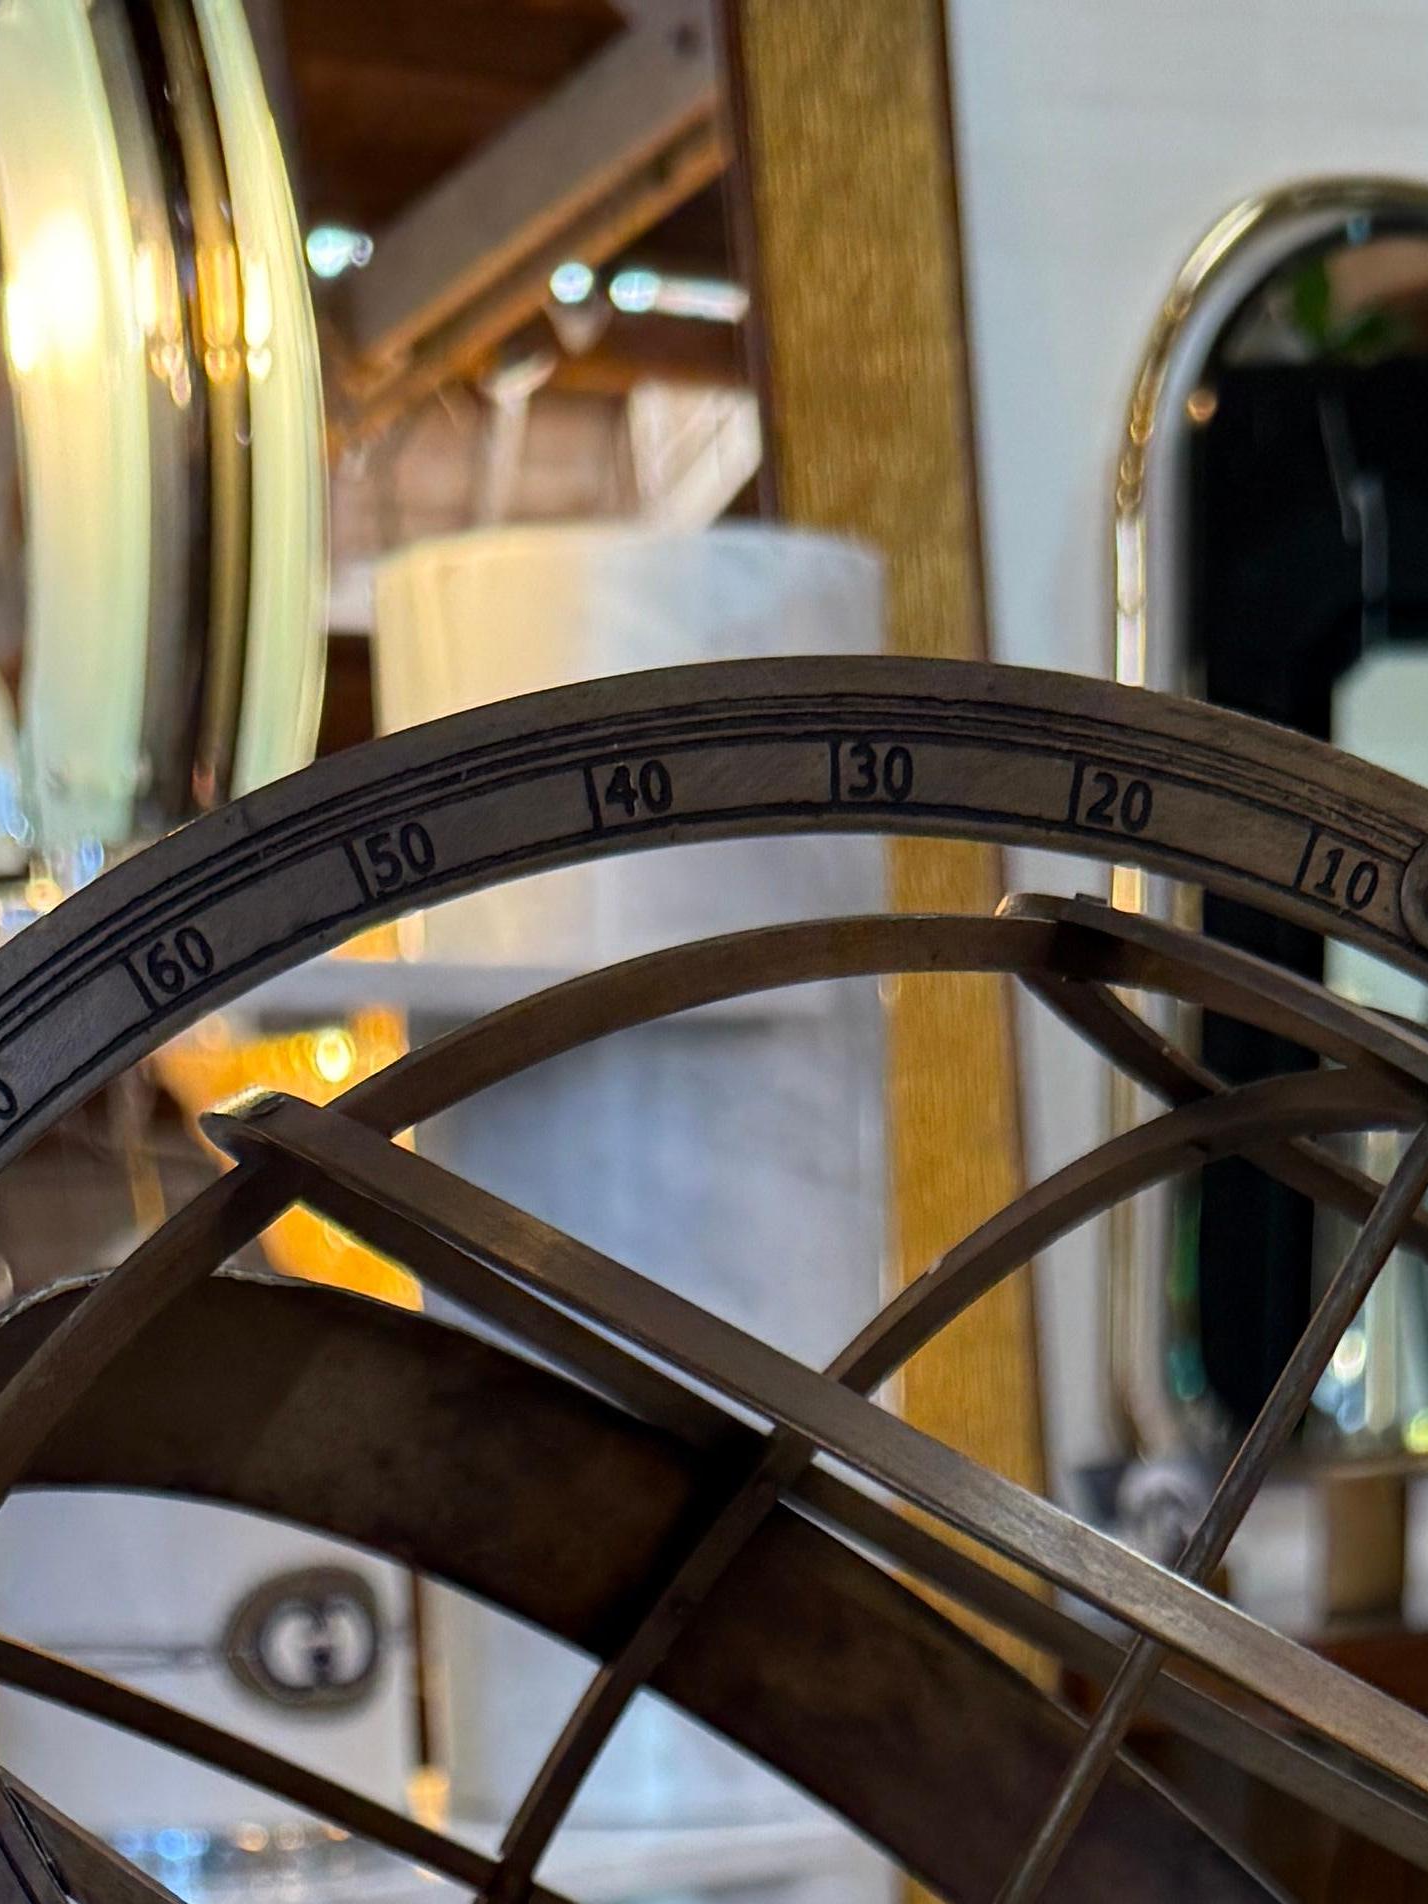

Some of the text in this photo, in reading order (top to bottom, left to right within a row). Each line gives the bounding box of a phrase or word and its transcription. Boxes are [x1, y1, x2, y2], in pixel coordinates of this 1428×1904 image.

[604, 759, 673, 816] 40
[847, 742, 914, 802] 30
[1085, 771, 1153, 834] 20
[373, 822, 436, 889] 50
[1316, 846, 1380, 910] 10
[147, 926, 214, 996] 60
